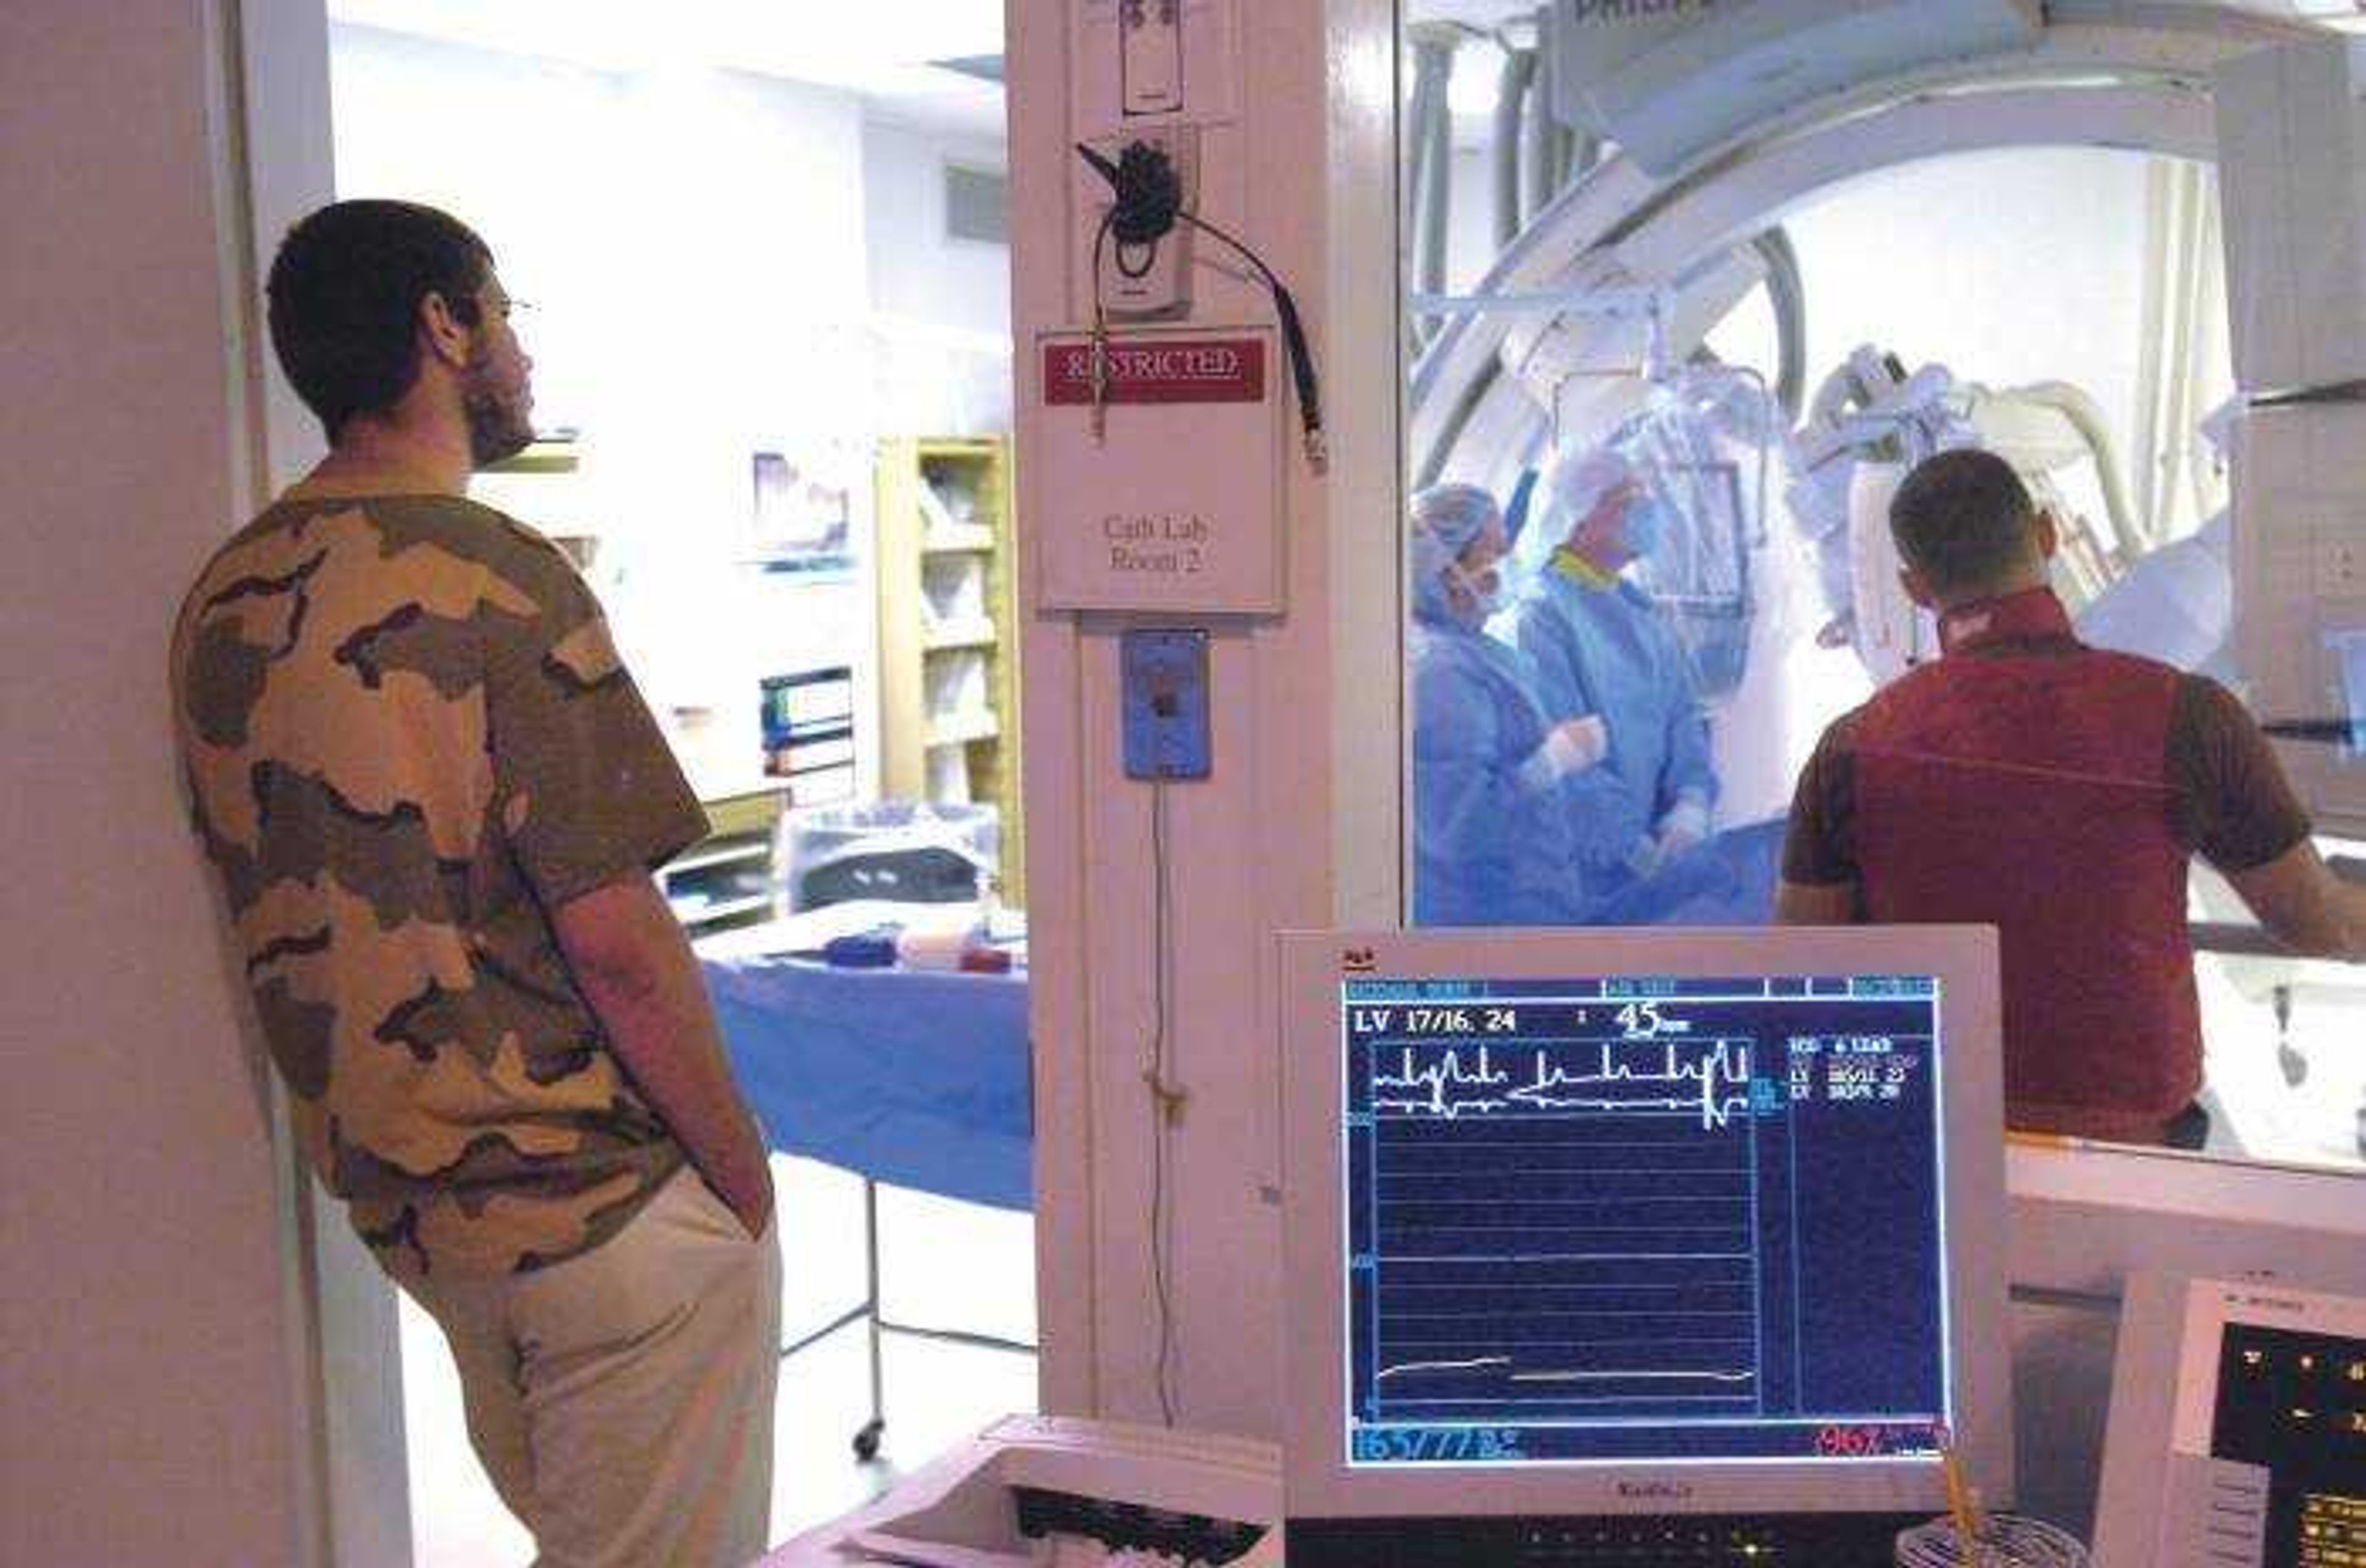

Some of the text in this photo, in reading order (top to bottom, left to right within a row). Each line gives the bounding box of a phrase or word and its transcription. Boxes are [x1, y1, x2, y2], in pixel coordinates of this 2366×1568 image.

[1067, 349, 1239, 379] RSTRICTED
[1110, 548, 1201, 572] Room 2
[1354, 1010, 1391, 1032] LV
[1485, 1009, 1516, 1032] 24
